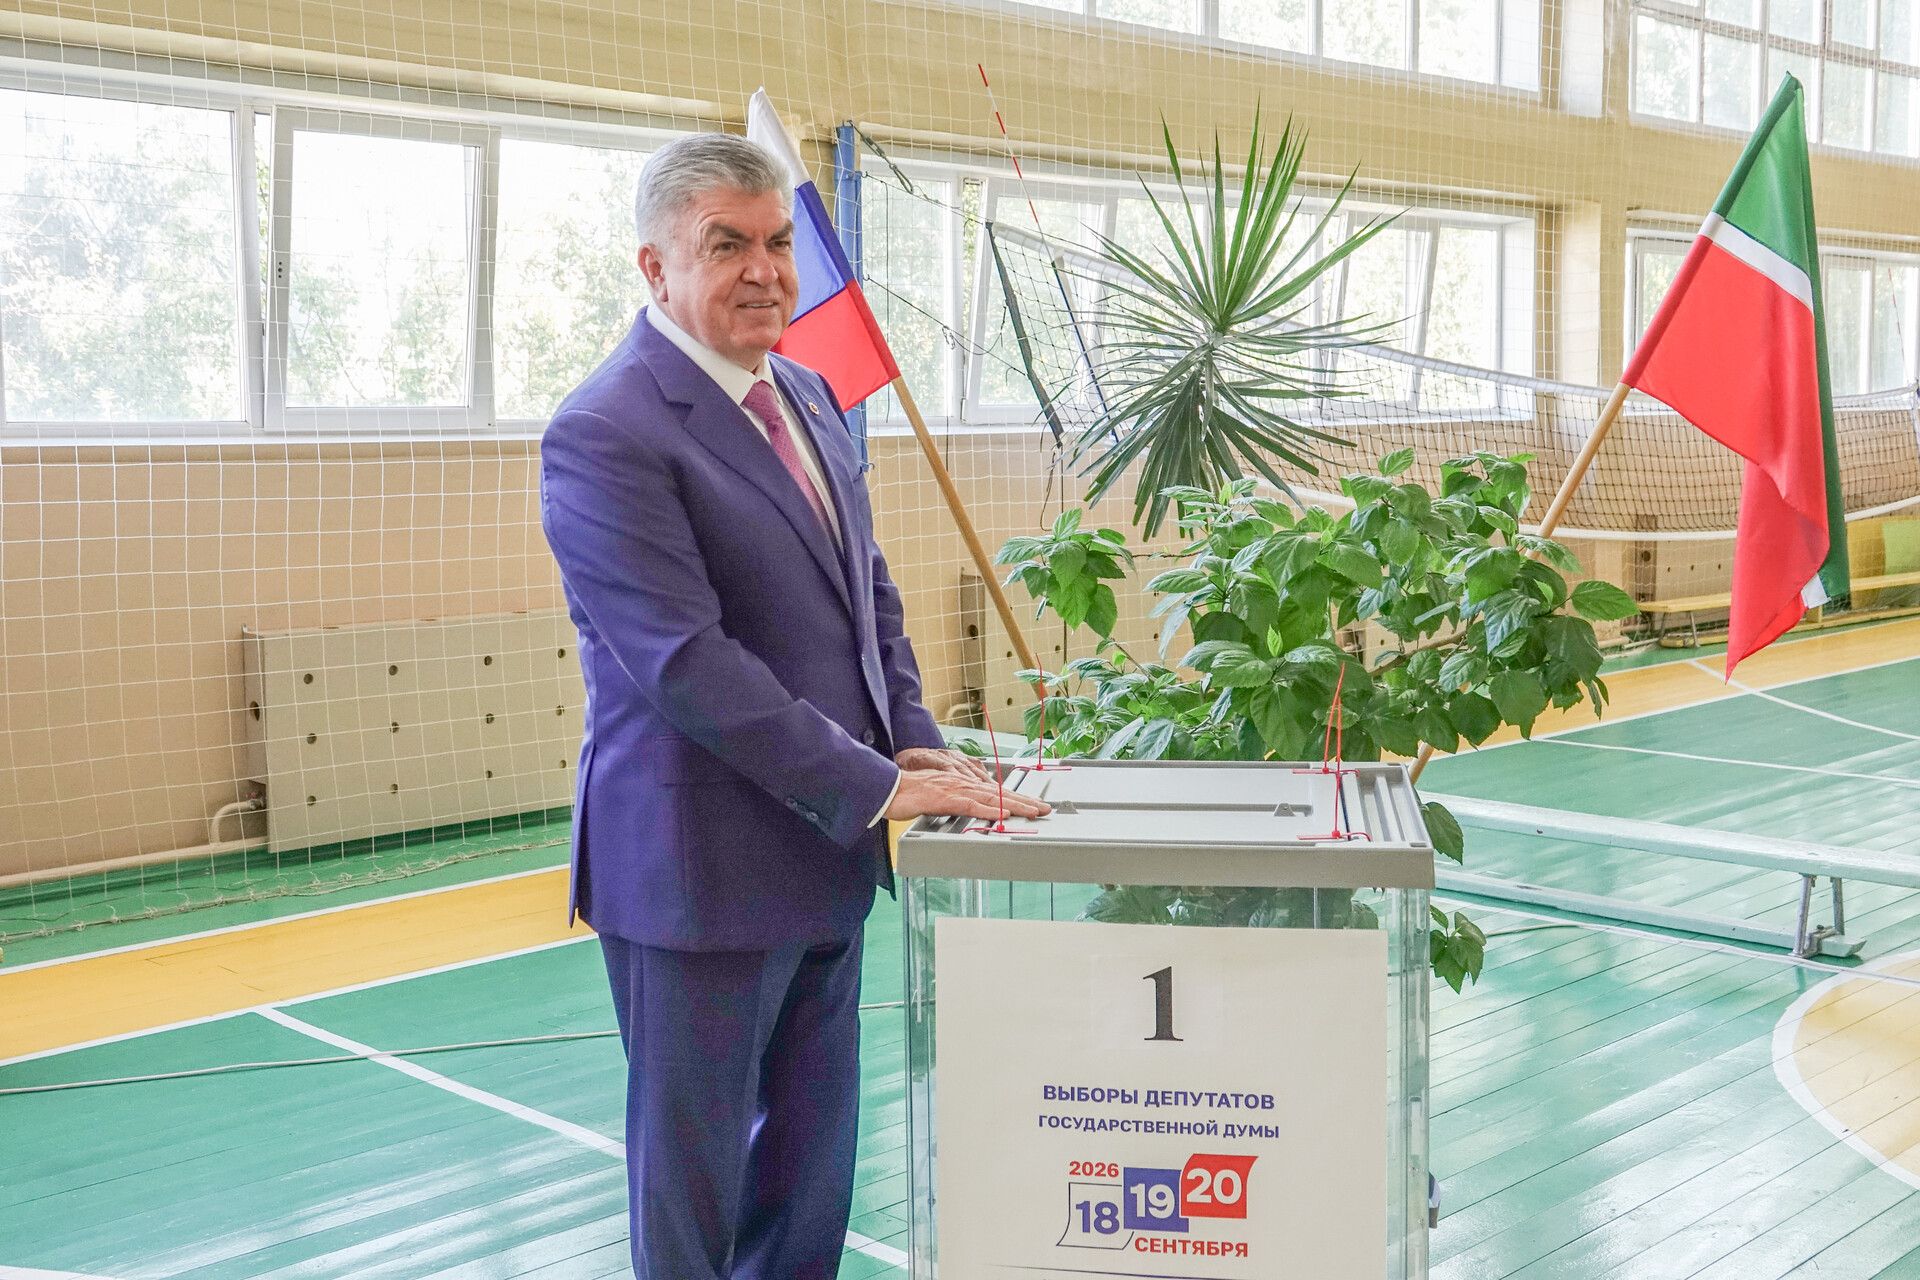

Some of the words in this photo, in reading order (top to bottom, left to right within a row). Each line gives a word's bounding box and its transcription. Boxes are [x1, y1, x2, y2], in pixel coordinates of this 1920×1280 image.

[1143, 966, 1183, 1041] 1
[1043, 1085, 1139, 1105] ВЫБОРЫ
[1144, 1089, 1275, 1110] ДЕПУТАТОВ
[1038, 1115, 1219, 1136] ГОСУДАРСТВЕННОЙ
[1222, 1123, 1280, 1139] ДУМЫ
[1068, 1160, 1120, 1178] 2026
[1075, 1200, 1120, 1235] 18
[1129, 1183, 1175, 1219] 19
[1186, 1167, 1243, 1205] 20
[1134, 1236, 1249, 1258] СЕНТЯБРЯ
